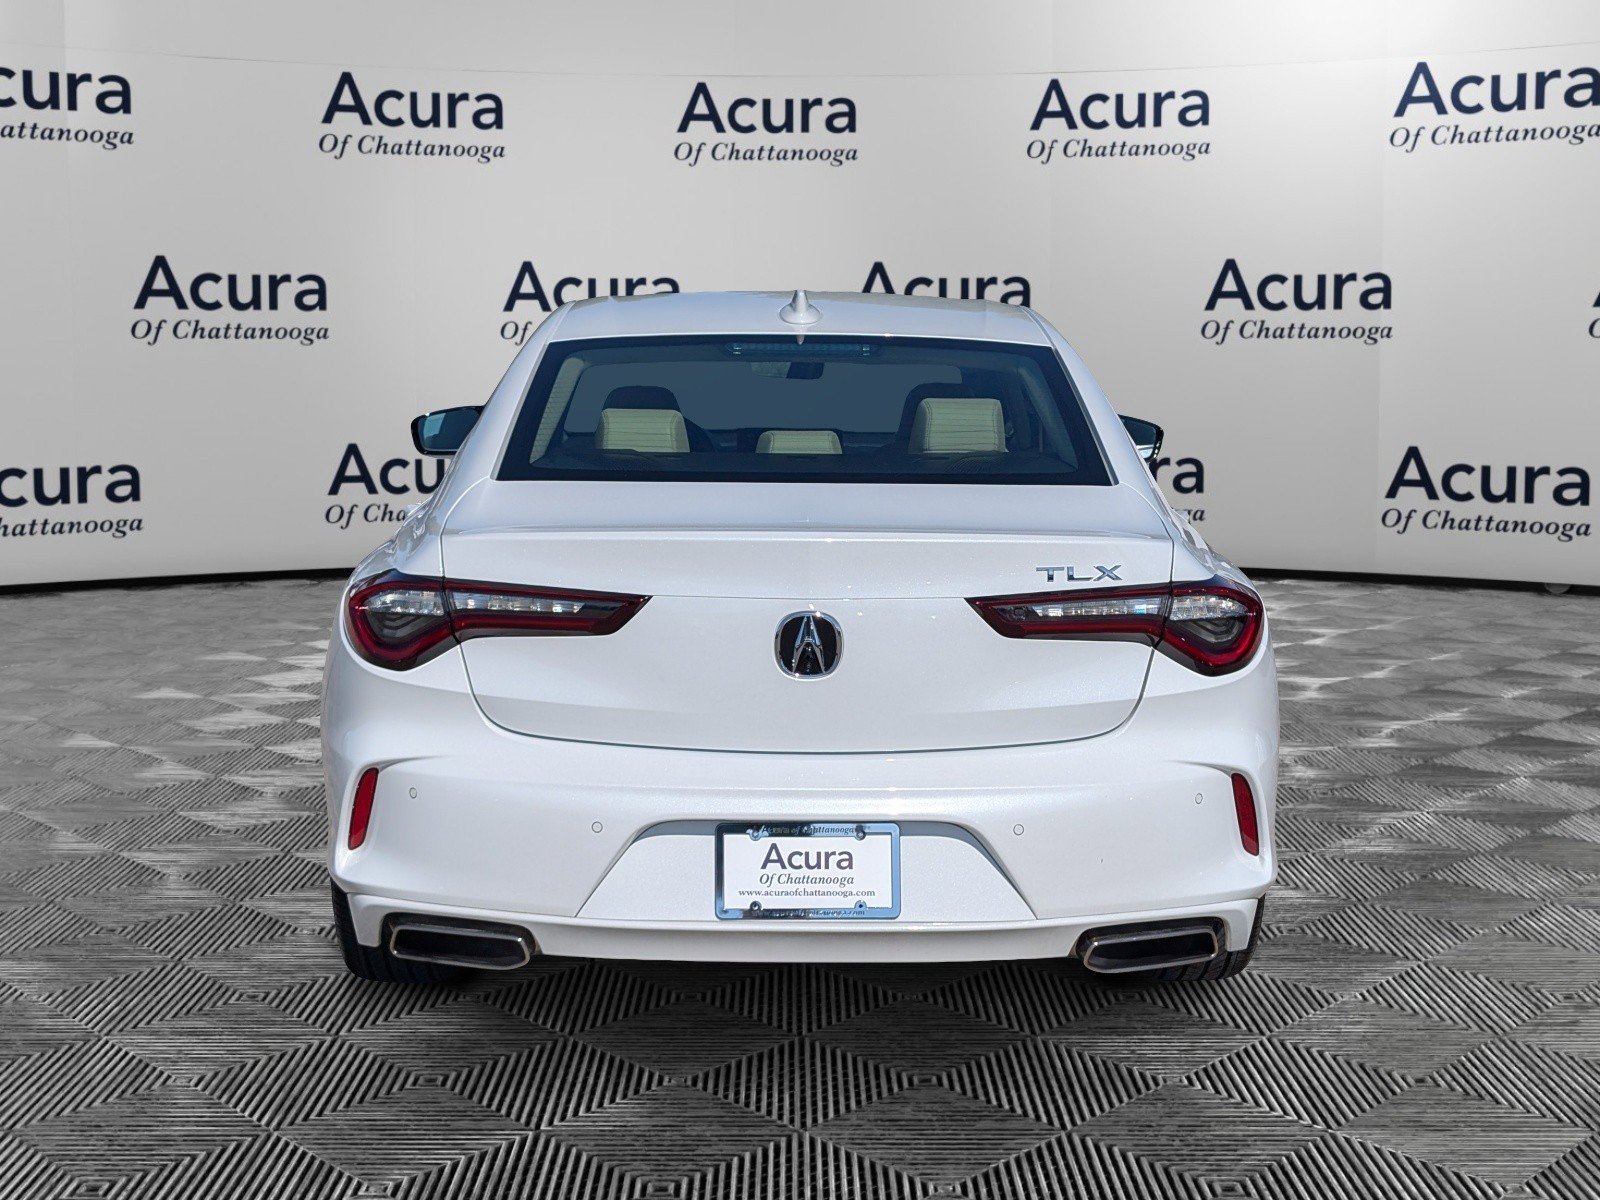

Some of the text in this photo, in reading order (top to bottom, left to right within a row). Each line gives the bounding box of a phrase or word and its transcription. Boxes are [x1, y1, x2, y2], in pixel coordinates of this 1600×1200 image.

[0, 66, 132, 115] ura
[320, 71, 504, 131] Acura
[1029, 78, 1210, 132] Acura
[1393, 61, 1600, 118] Acura
[676, 82, 857, 135] Acura
[0, 121, 134, 151] attanooga
[318, 133, 506, 164] Of Chattanooga
[1026, 138, 1211, 165] Of Chattanooga
[1389, 123, 1600, 154] Of Chattanooga
[673, 141, 859, 168] Of Chattanooga
[133, 254, 328, 313] Acura
[1203, 257, 1393, 312] Acura
[130, 318, 330, 347] Of Chattanooga
[500, 320, 533, 346] Of
[1200, 319, 1393, 346] Of Chattanooga
[327, 443, 445, 496] Acu
[1384, 445, 1591, 507] Acura
[0, 463, 142, 508] cura
[0, 517, 144, 539] hattanooga
[325, 504, 359, 530] Of
[1380, 507, 1592, 542] Of Chattanooga
[1035, 564, 1123, 582] TLX
[760, 842, 854, 870] Acura
[738, 888, 876, 899] www.acuraofchattanooga.com
[759, 873, 855, 887] Of Chattanooga
